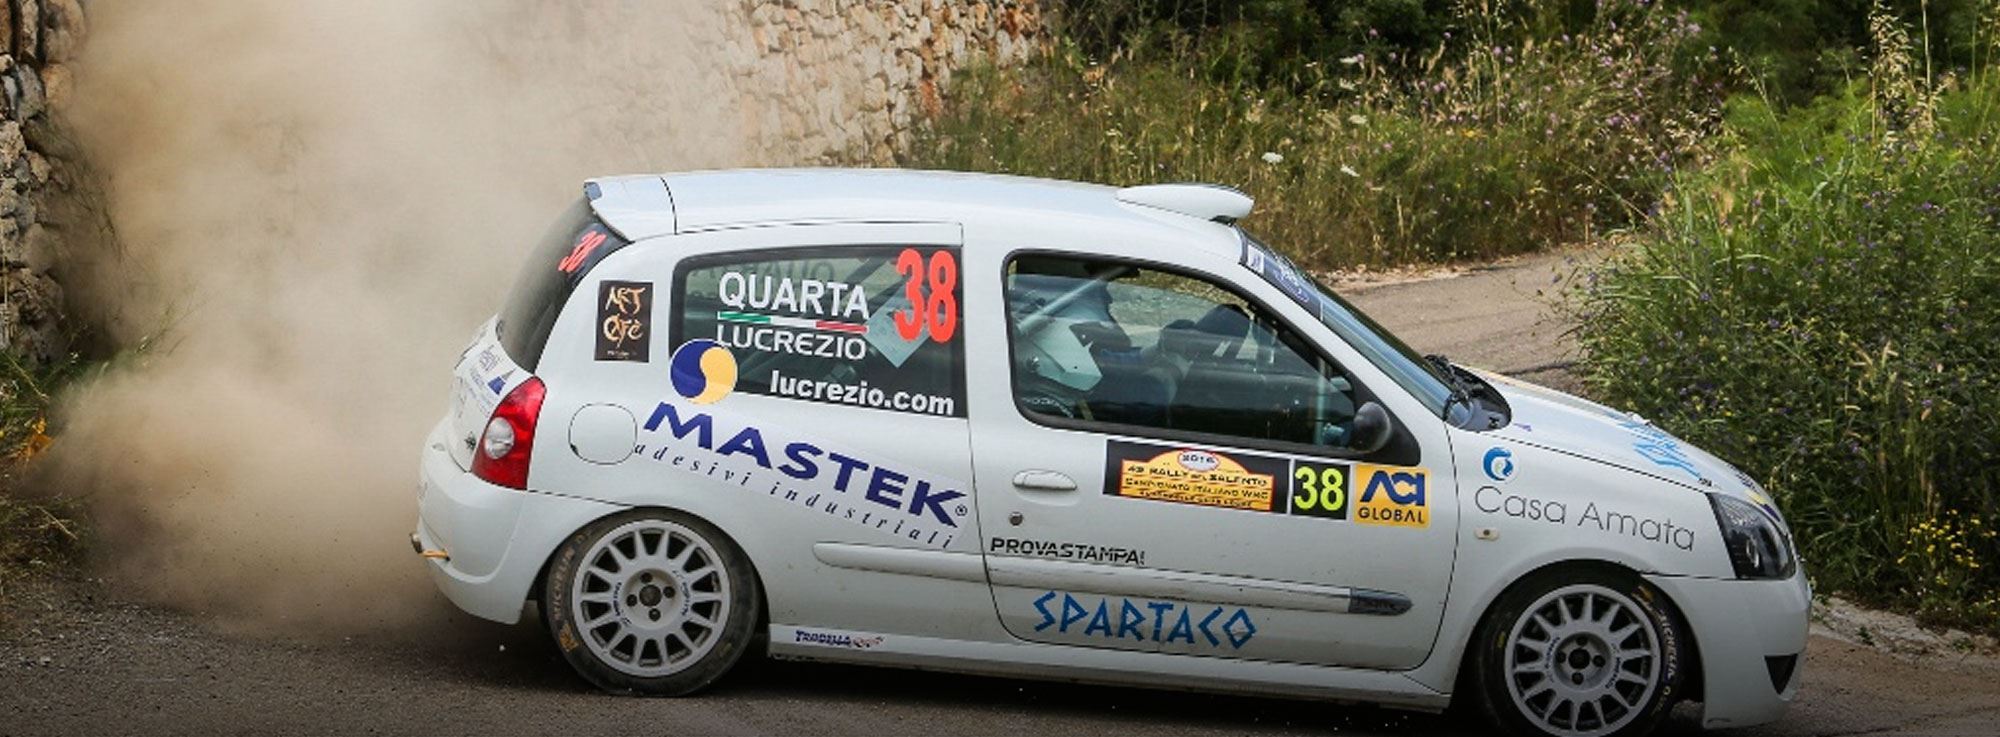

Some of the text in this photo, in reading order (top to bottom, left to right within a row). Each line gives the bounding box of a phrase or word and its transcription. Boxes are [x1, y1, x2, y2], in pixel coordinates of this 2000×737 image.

[718, 271, 871, 320] QUARTA
[894, 247, 957, 344] 38
[716, 323, 867, 361] LUCREZIO
[769, 369, 955, 416] lucrezio.com
[633, 443, 954, 549] adesivi industriali
[1294, 466, 1345, 512] 38
[1358, 506, 1426, 524] GLOBAL
[1474, 485, 1695, 552] Casa Amata
[1033, 590, 1256, 649] SPARTACO
